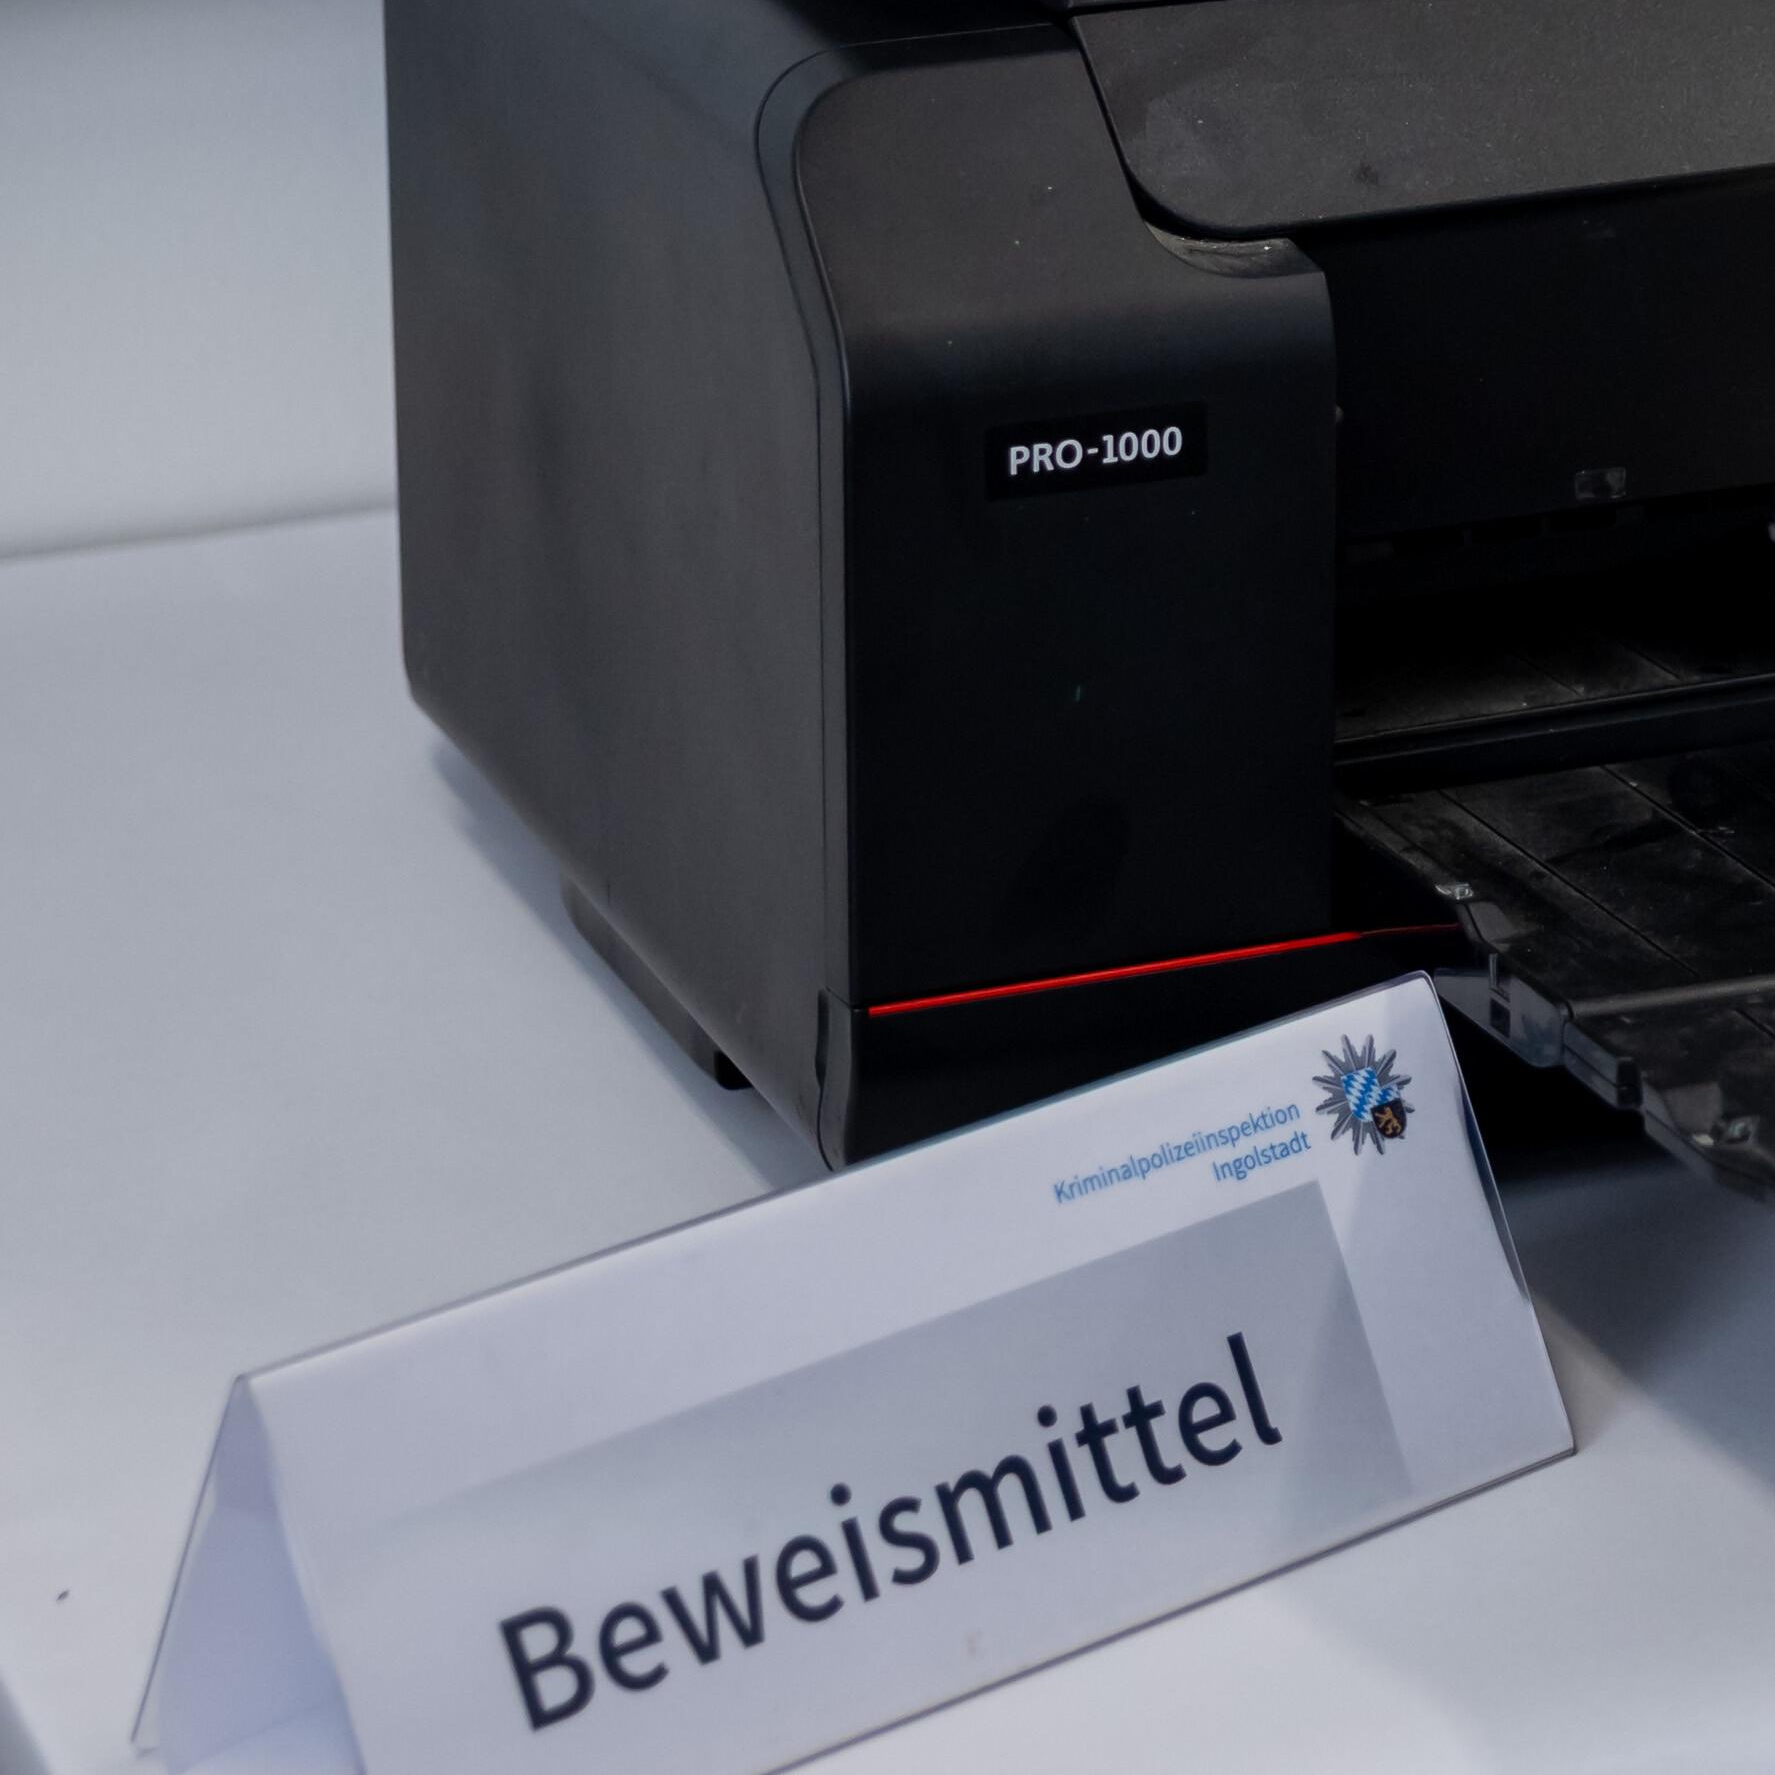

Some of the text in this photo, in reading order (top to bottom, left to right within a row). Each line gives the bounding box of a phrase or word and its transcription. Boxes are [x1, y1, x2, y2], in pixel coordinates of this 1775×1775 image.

[1009, 426, 1183, 476] PRO-1000
[1053, 1103, 1301, 1205] Kriminalpolizeiinspektion
[1212, 1131, 1312, 1182] Ingolstadt
[499, 1331, 1284, 1732] Beweismittel
